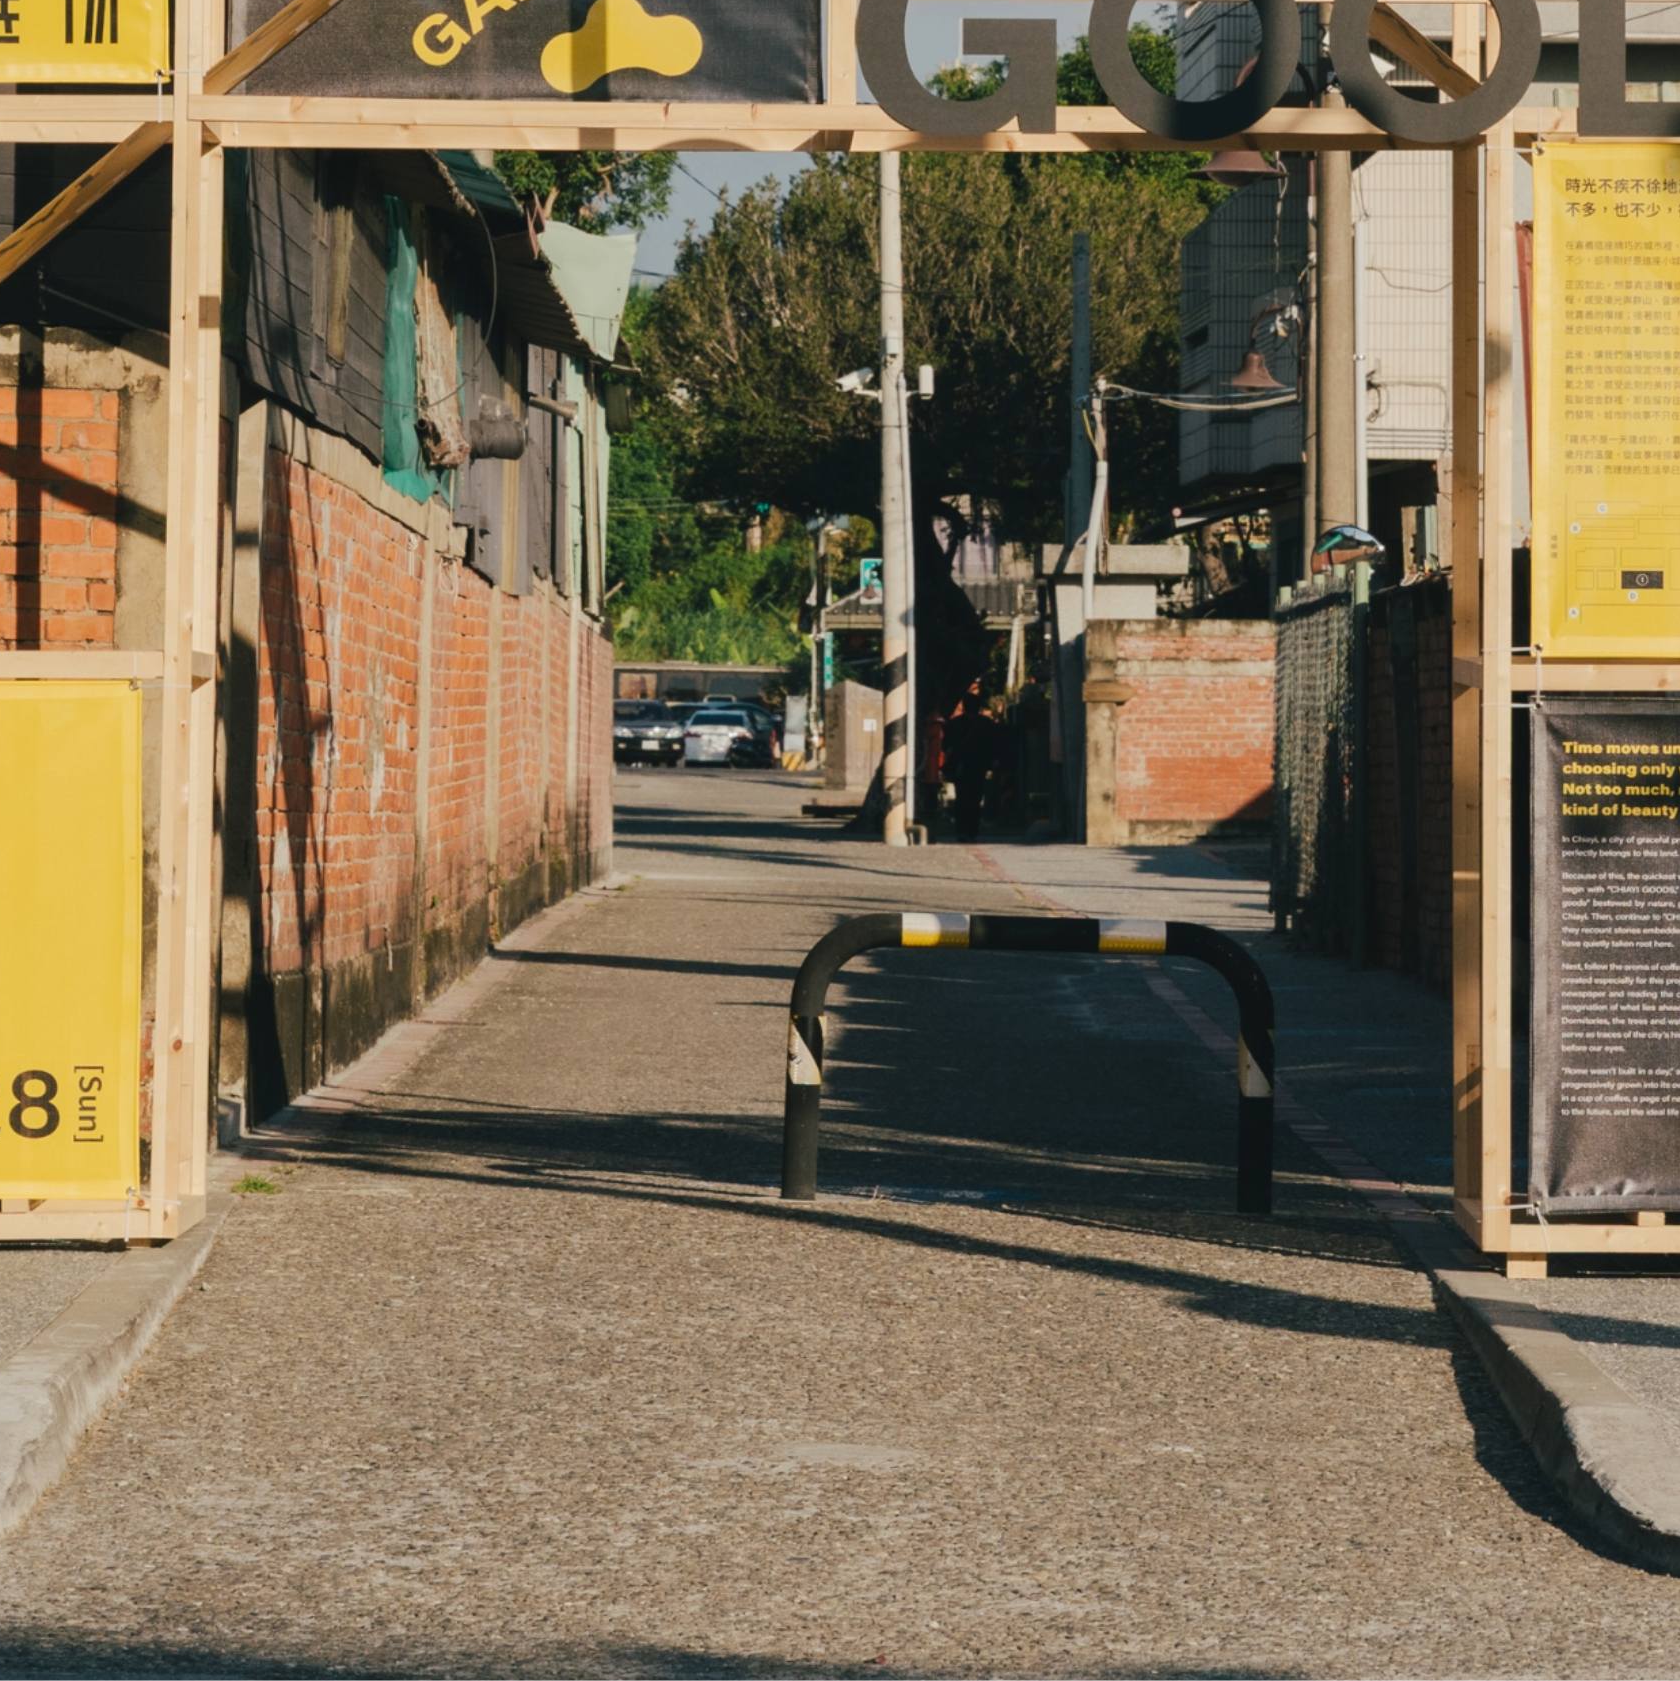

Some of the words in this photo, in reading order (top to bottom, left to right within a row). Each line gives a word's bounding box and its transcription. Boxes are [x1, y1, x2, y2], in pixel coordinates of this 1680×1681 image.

[1562, 742, 1603, 754] Time
[1607, 744, 1658, 755] moves
[1562, 762, 1637, 777] choosing
[1641, 763, 1676, 777] only
[1562, 783, 1592, 796] Not
[1596, 783, 1621, 796] too
[1626, 783, 1674, 798] much,
[1562, 803, 1598, 816] kind
[1602, 804, 1618, 816] of
[1623, 804, 1678, 818] beauty
[73, 1065, 104, 1144] [Sun]
